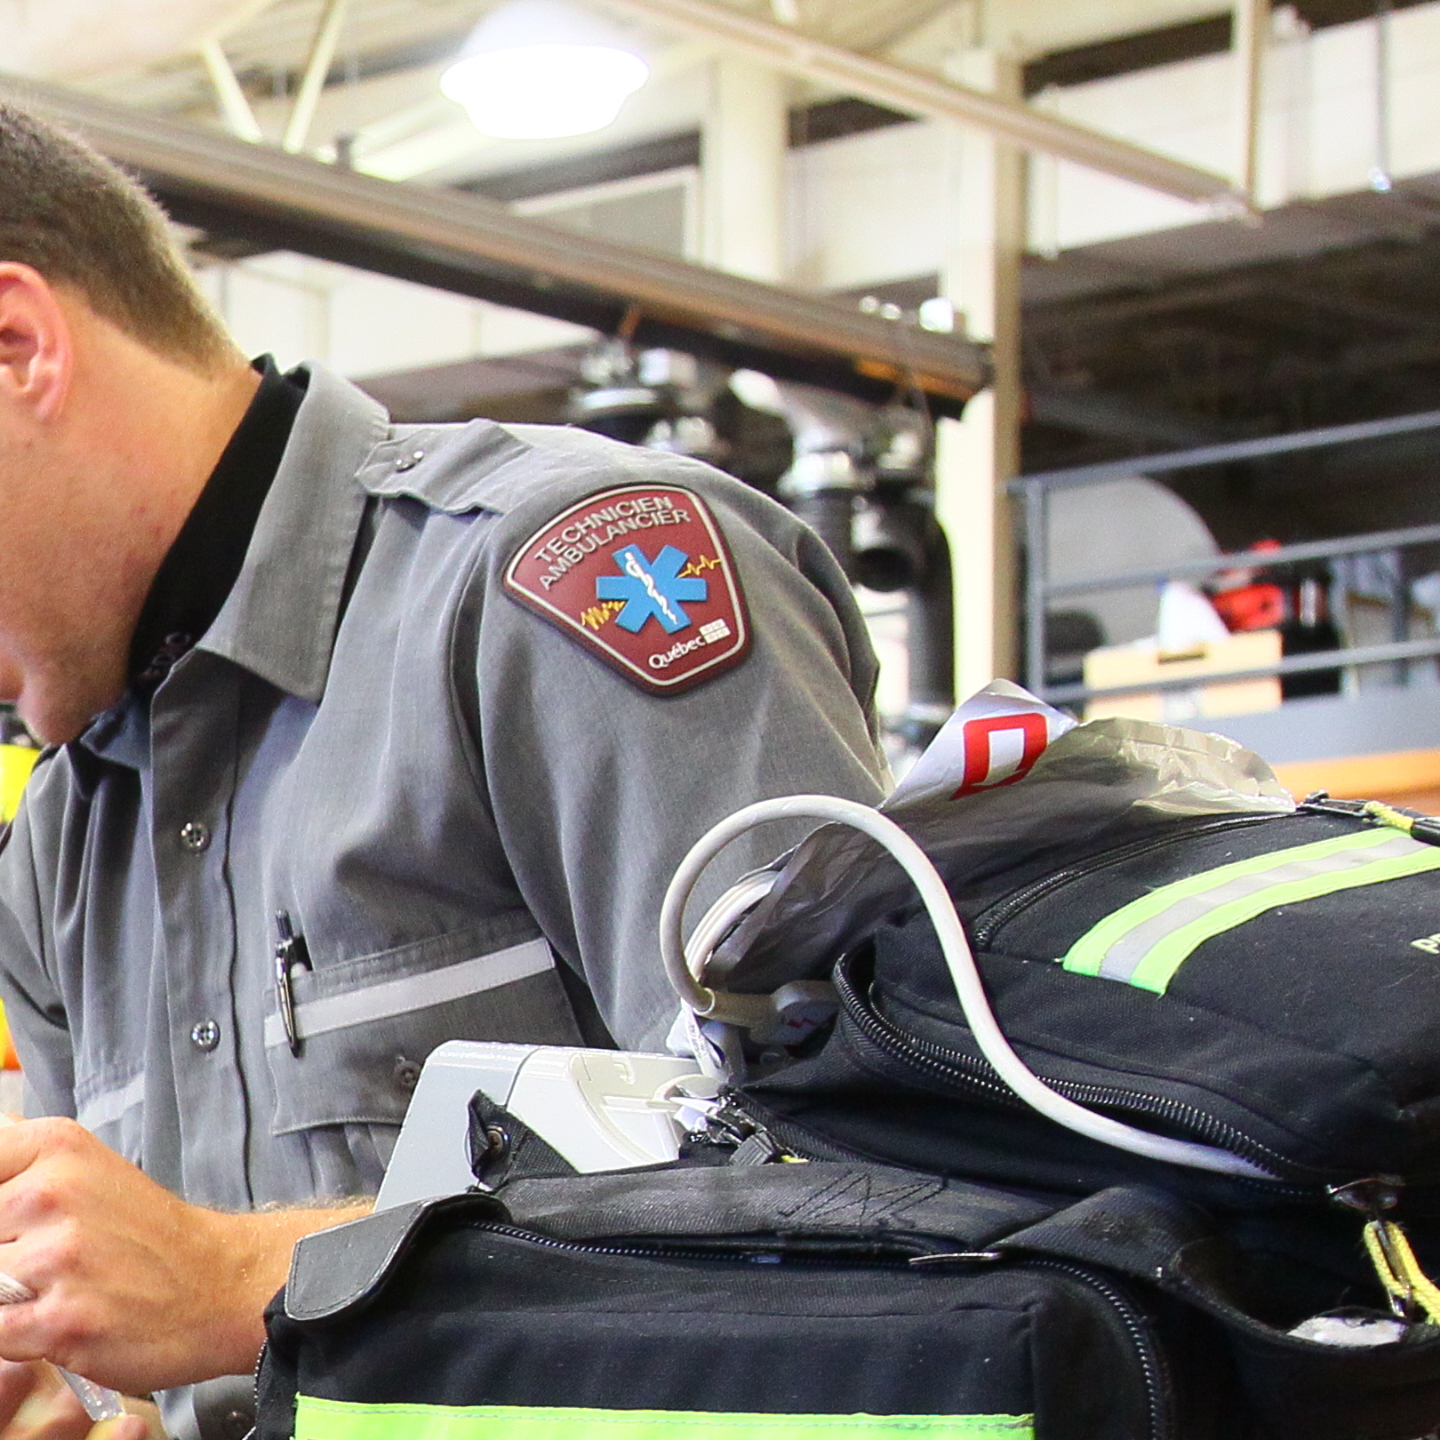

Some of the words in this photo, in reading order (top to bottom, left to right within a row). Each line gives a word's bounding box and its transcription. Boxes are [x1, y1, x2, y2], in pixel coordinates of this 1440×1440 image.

[534, 496, 674, 564] TECHNICIEN
[538, 509, 692, 591] AMBULANCIER
[648, 634, 707, 670] Québec
